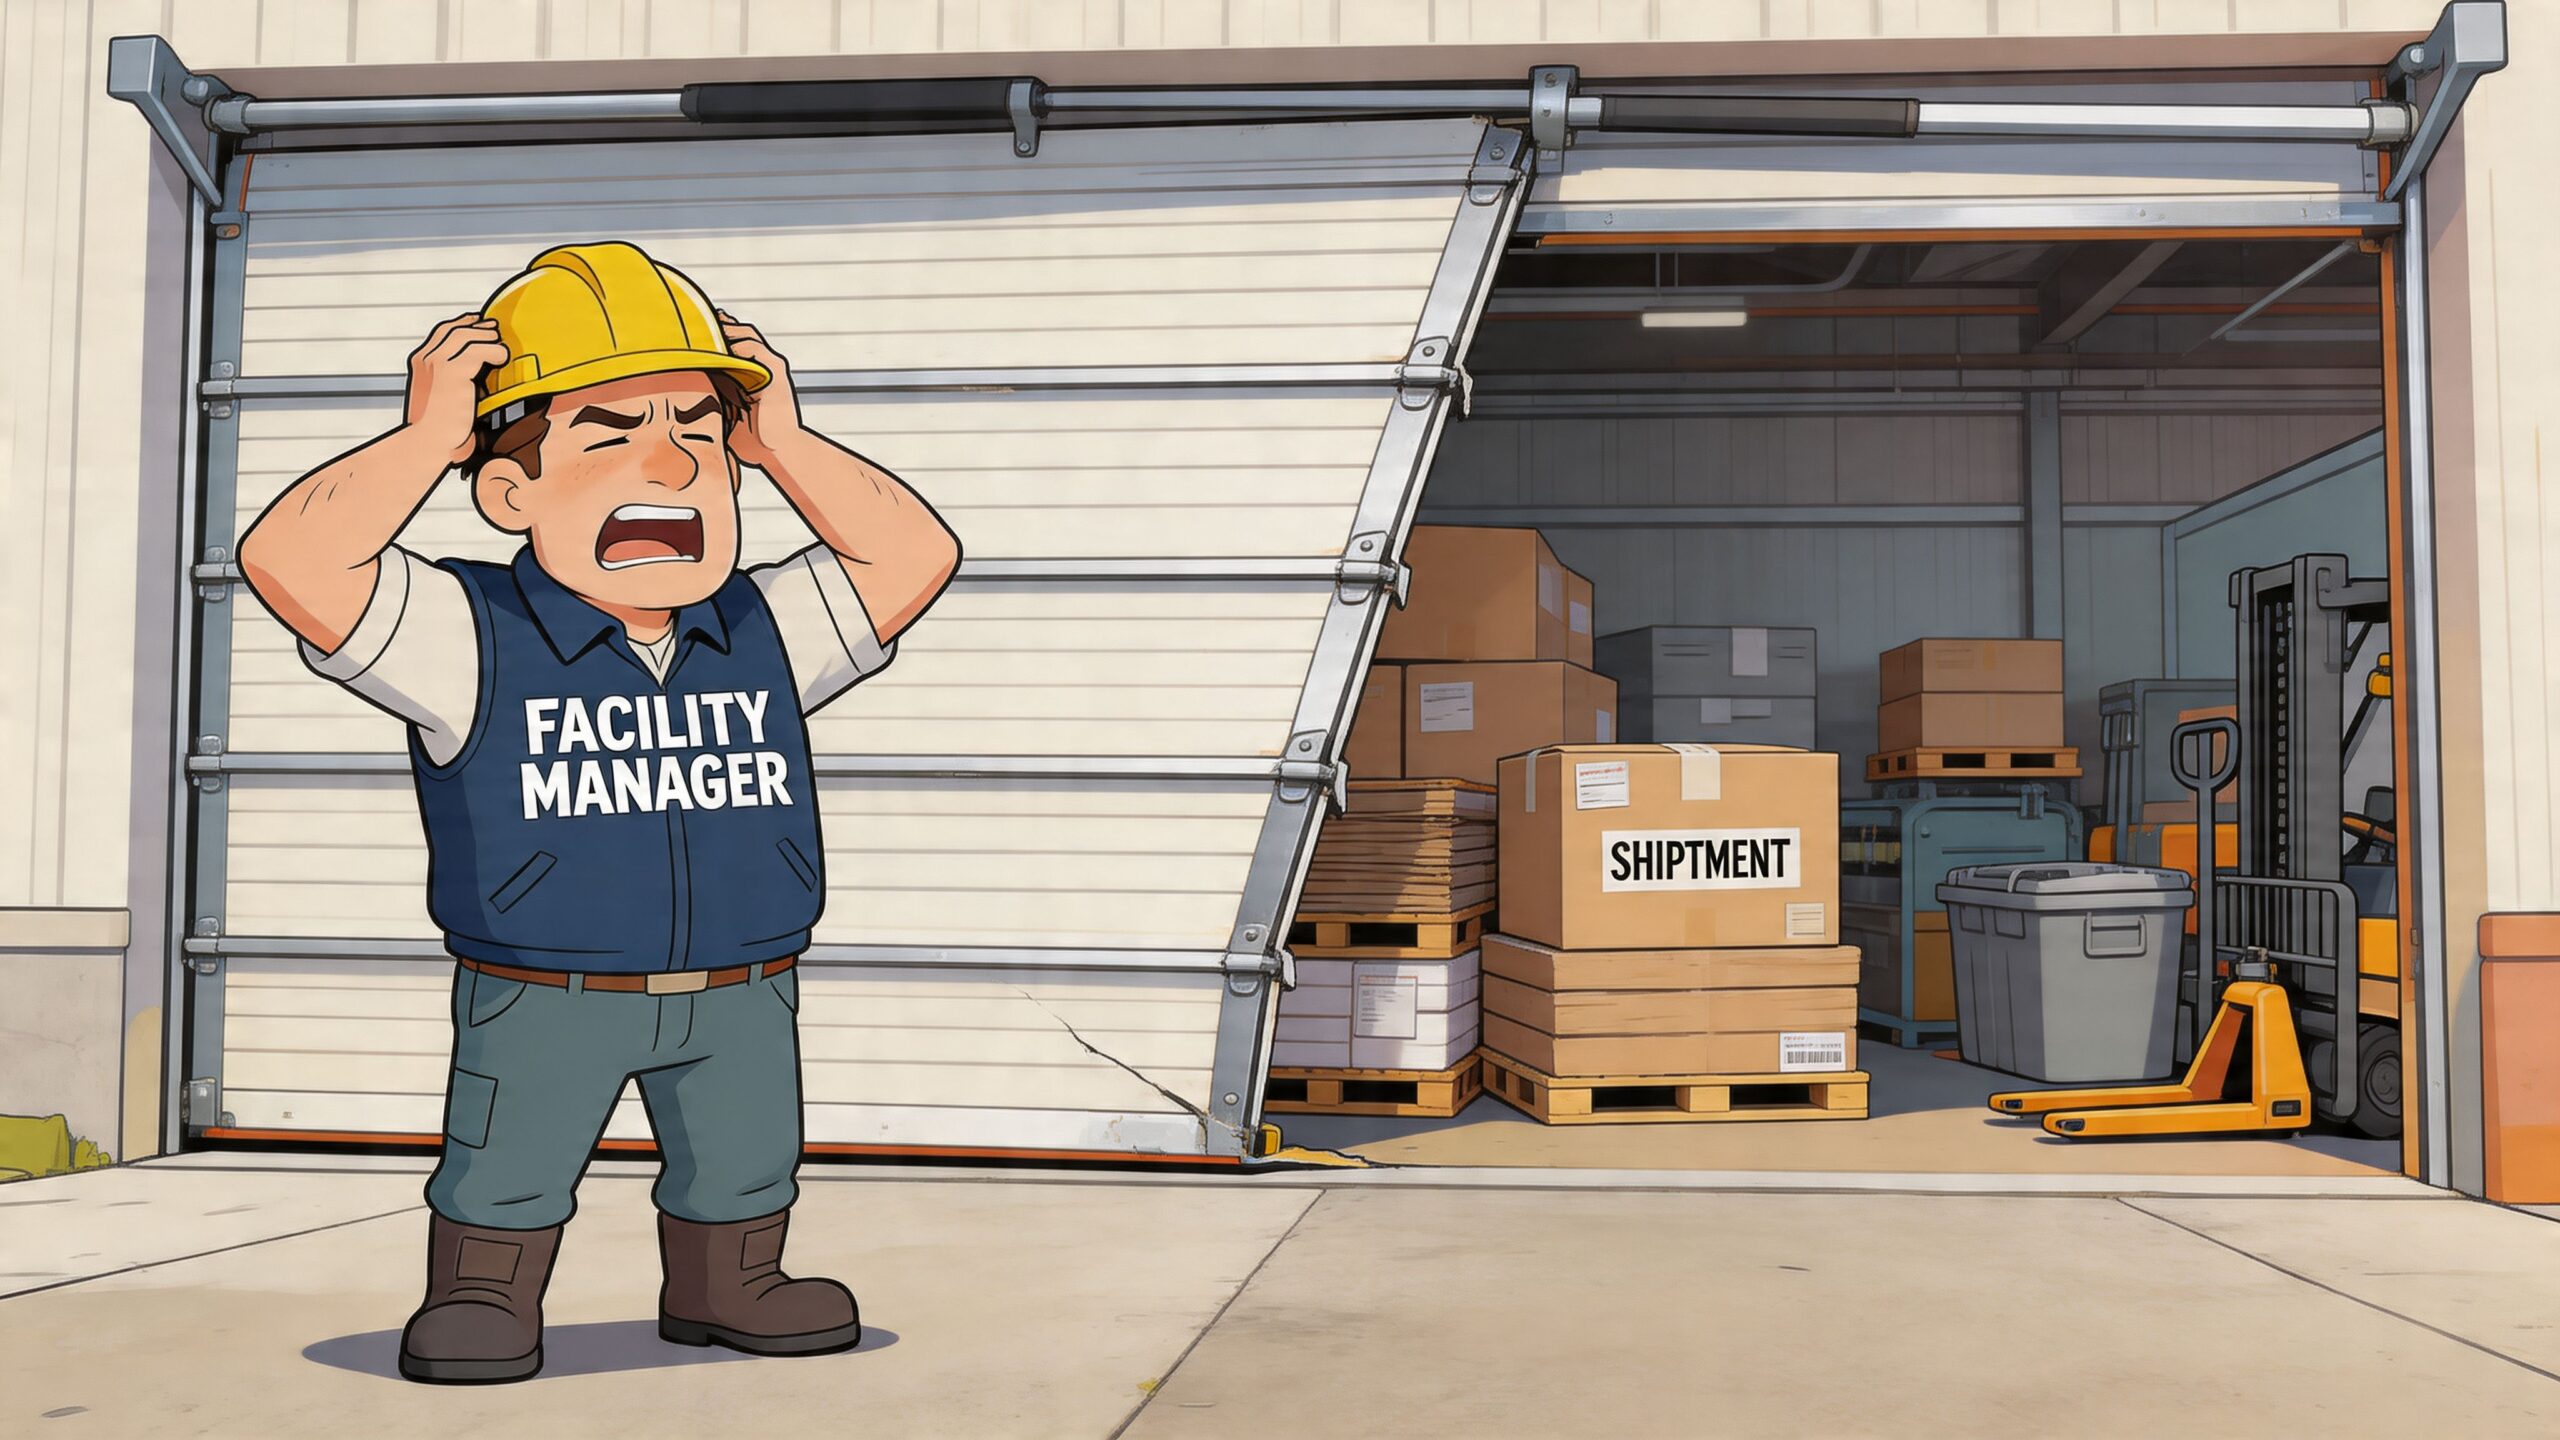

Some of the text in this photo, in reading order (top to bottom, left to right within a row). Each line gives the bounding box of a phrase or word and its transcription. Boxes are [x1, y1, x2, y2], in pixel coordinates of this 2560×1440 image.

[525, 690, 769, 756] FACILITY
[520, 751, 794, 820] MANAGER
[1610, 838, 1791, 882] SHIPTMENT
